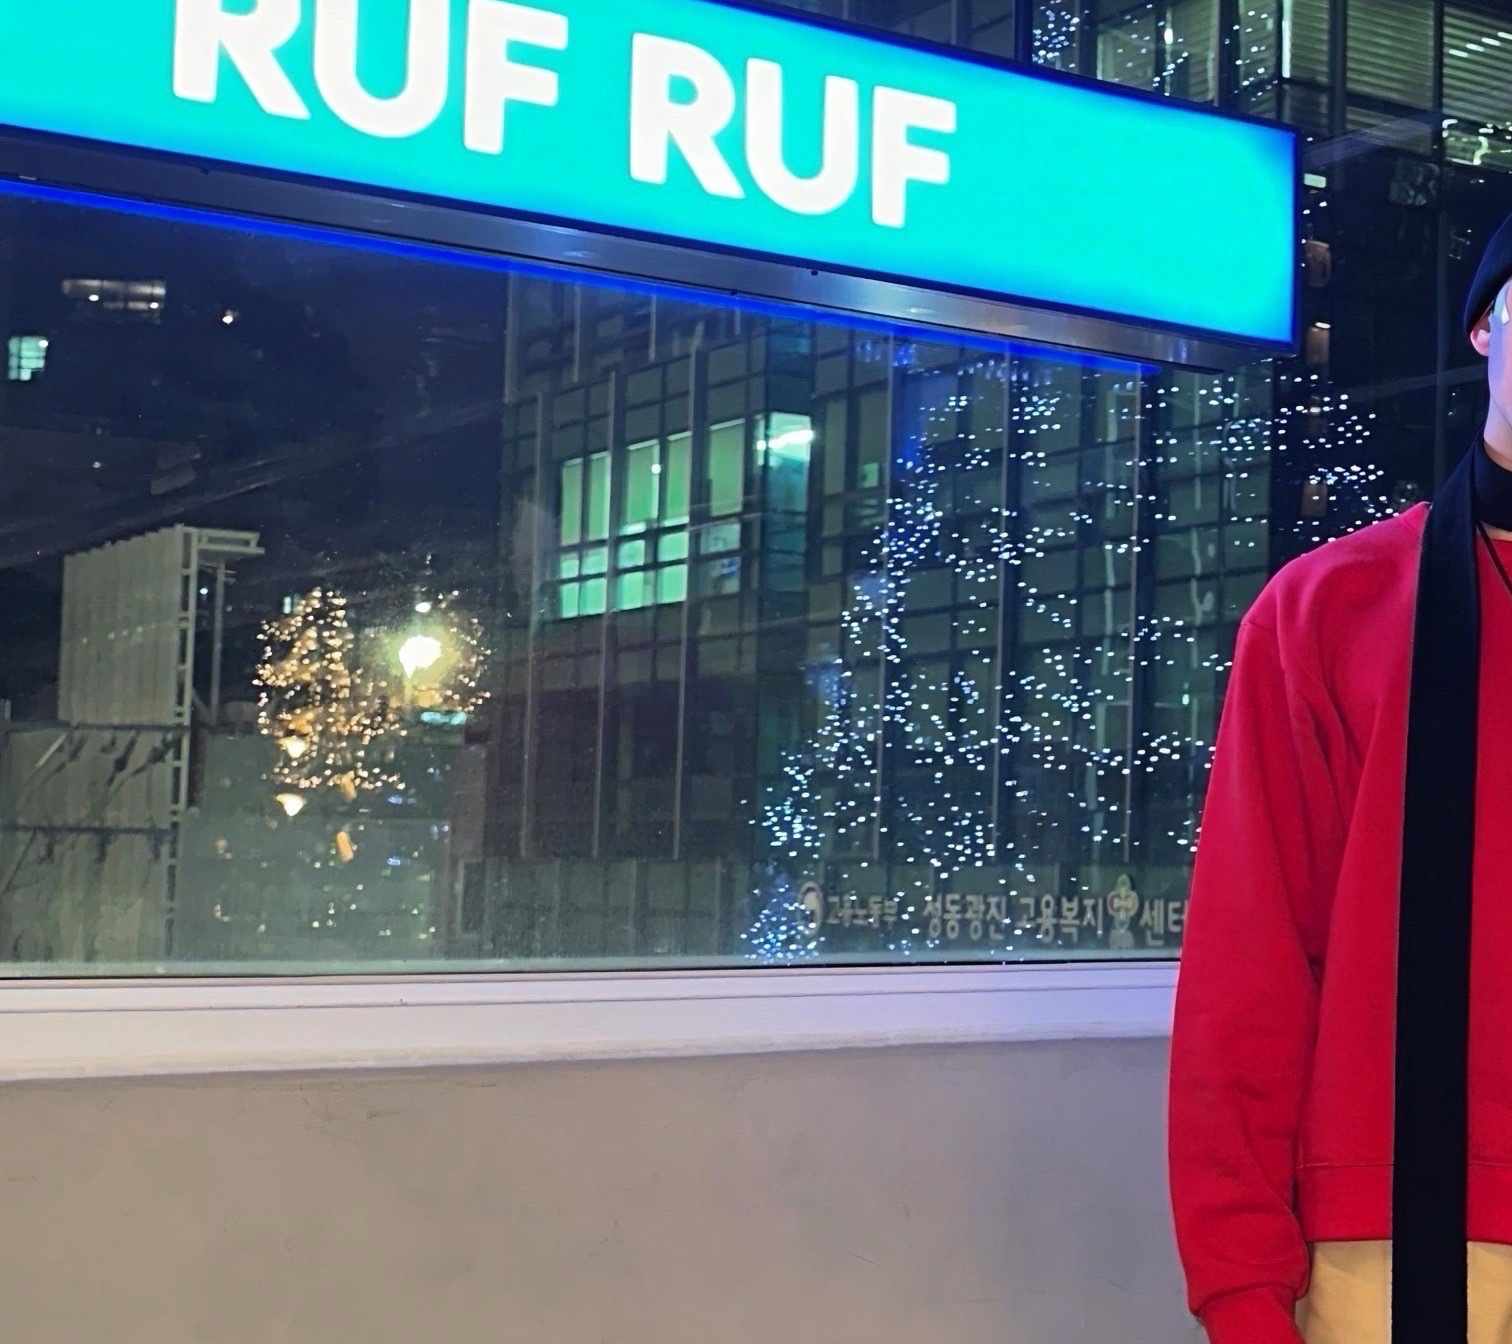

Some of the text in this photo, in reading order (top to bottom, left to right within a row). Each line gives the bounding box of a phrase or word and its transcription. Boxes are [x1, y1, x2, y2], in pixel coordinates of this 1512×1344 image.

[629, 33, 957, 228] RUF
[922, 892, 1007, 941] 성동광진
[1014, 894, 1104, 943] 고용복지
